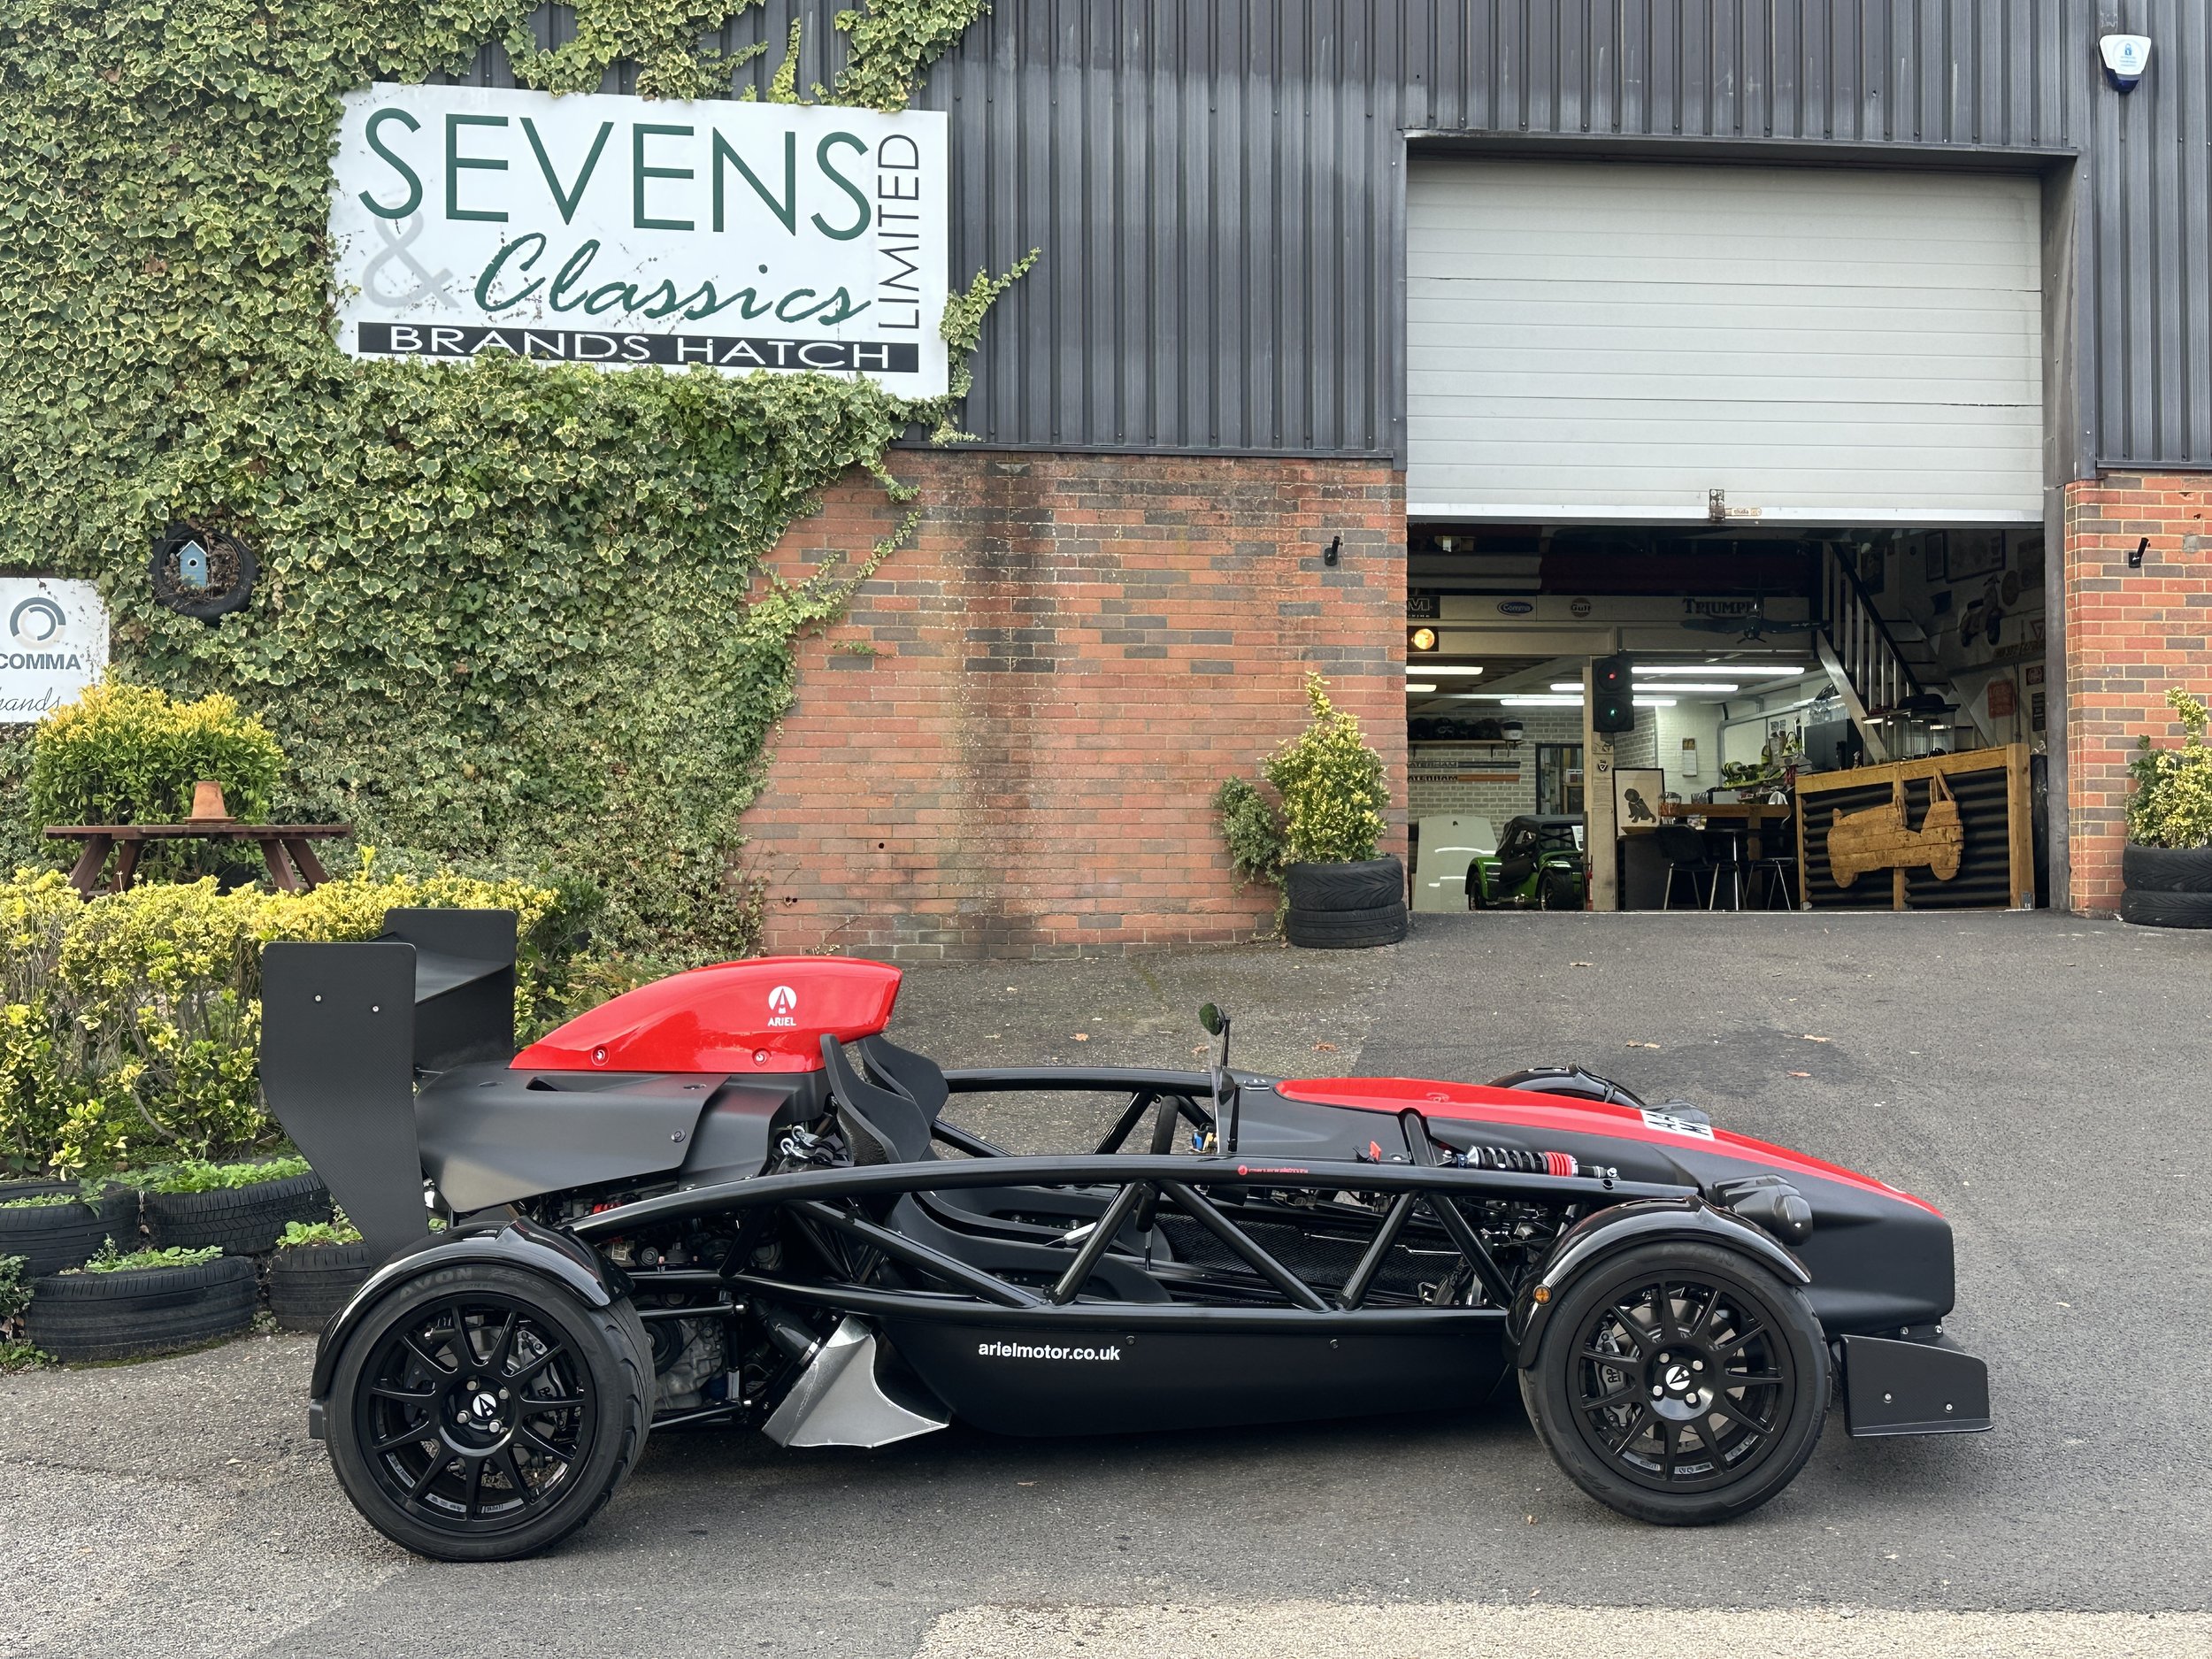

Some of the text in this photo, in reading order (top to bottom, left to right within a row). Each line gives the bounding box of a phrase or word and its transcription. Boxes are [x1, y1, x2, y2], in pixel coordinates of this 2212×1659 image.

[358, 107, 872, 241] SEVENS
[878, 134, 919, 329] LIMITED
[473, 232, 872, 326] Classics
[390, 326, 888, 369] BRANDS HATCH
[767, 1017, 797, 1027] ARIEL
[399, 1267, 473, 1302] AVON
[978, 1340, 1121, 1361] arielmotor.co.uk
